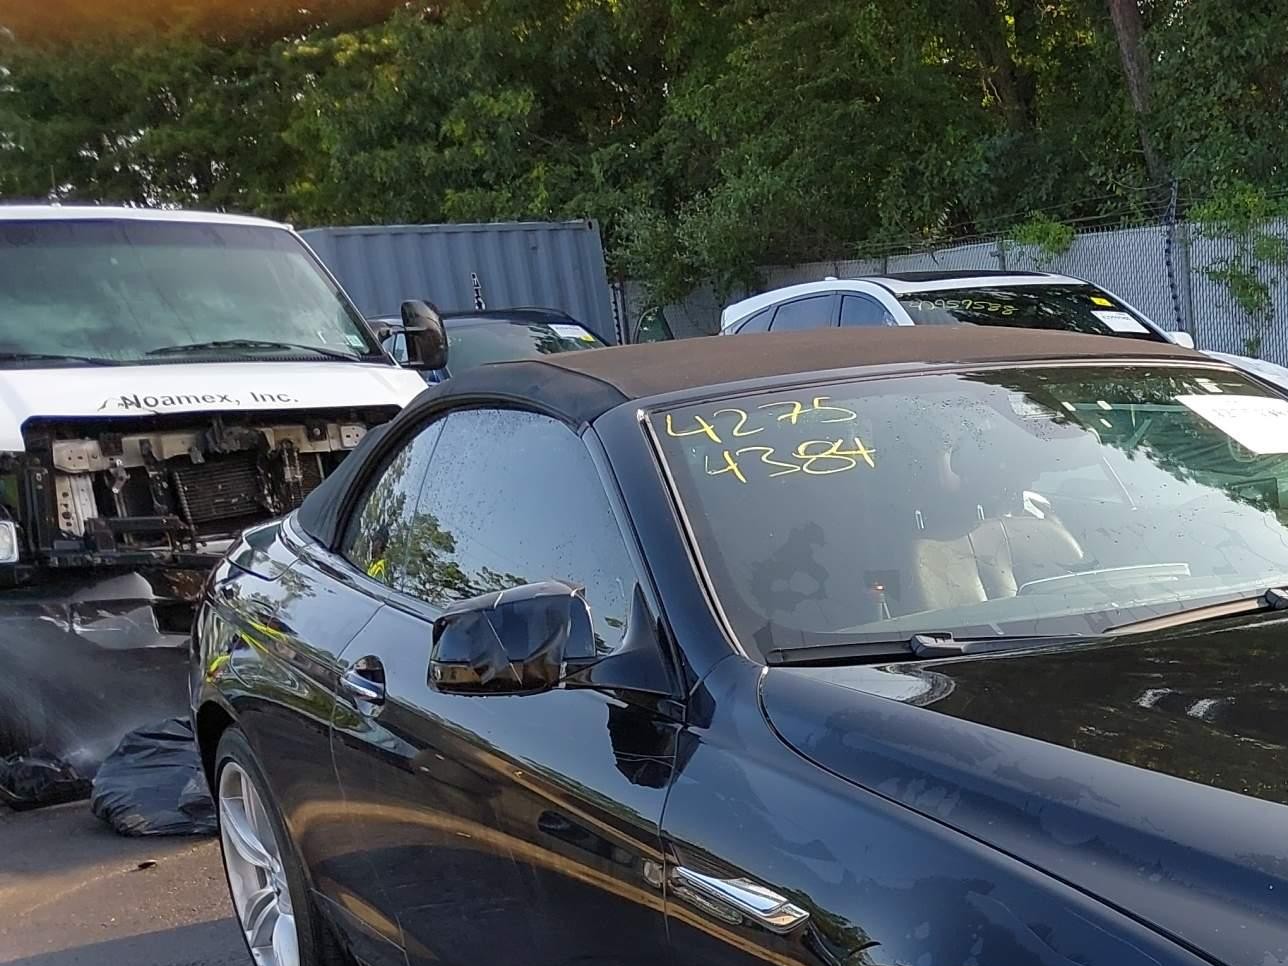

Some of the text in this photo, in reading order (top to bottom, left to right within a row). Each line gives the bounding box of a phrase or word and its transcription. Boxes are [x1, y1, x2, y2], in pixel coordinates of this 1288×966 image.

[119, 391, 299, 409] Noamex, Inc.
[666, 396, 857, 444] 4275
[705, 437, 876, 483] 4384
